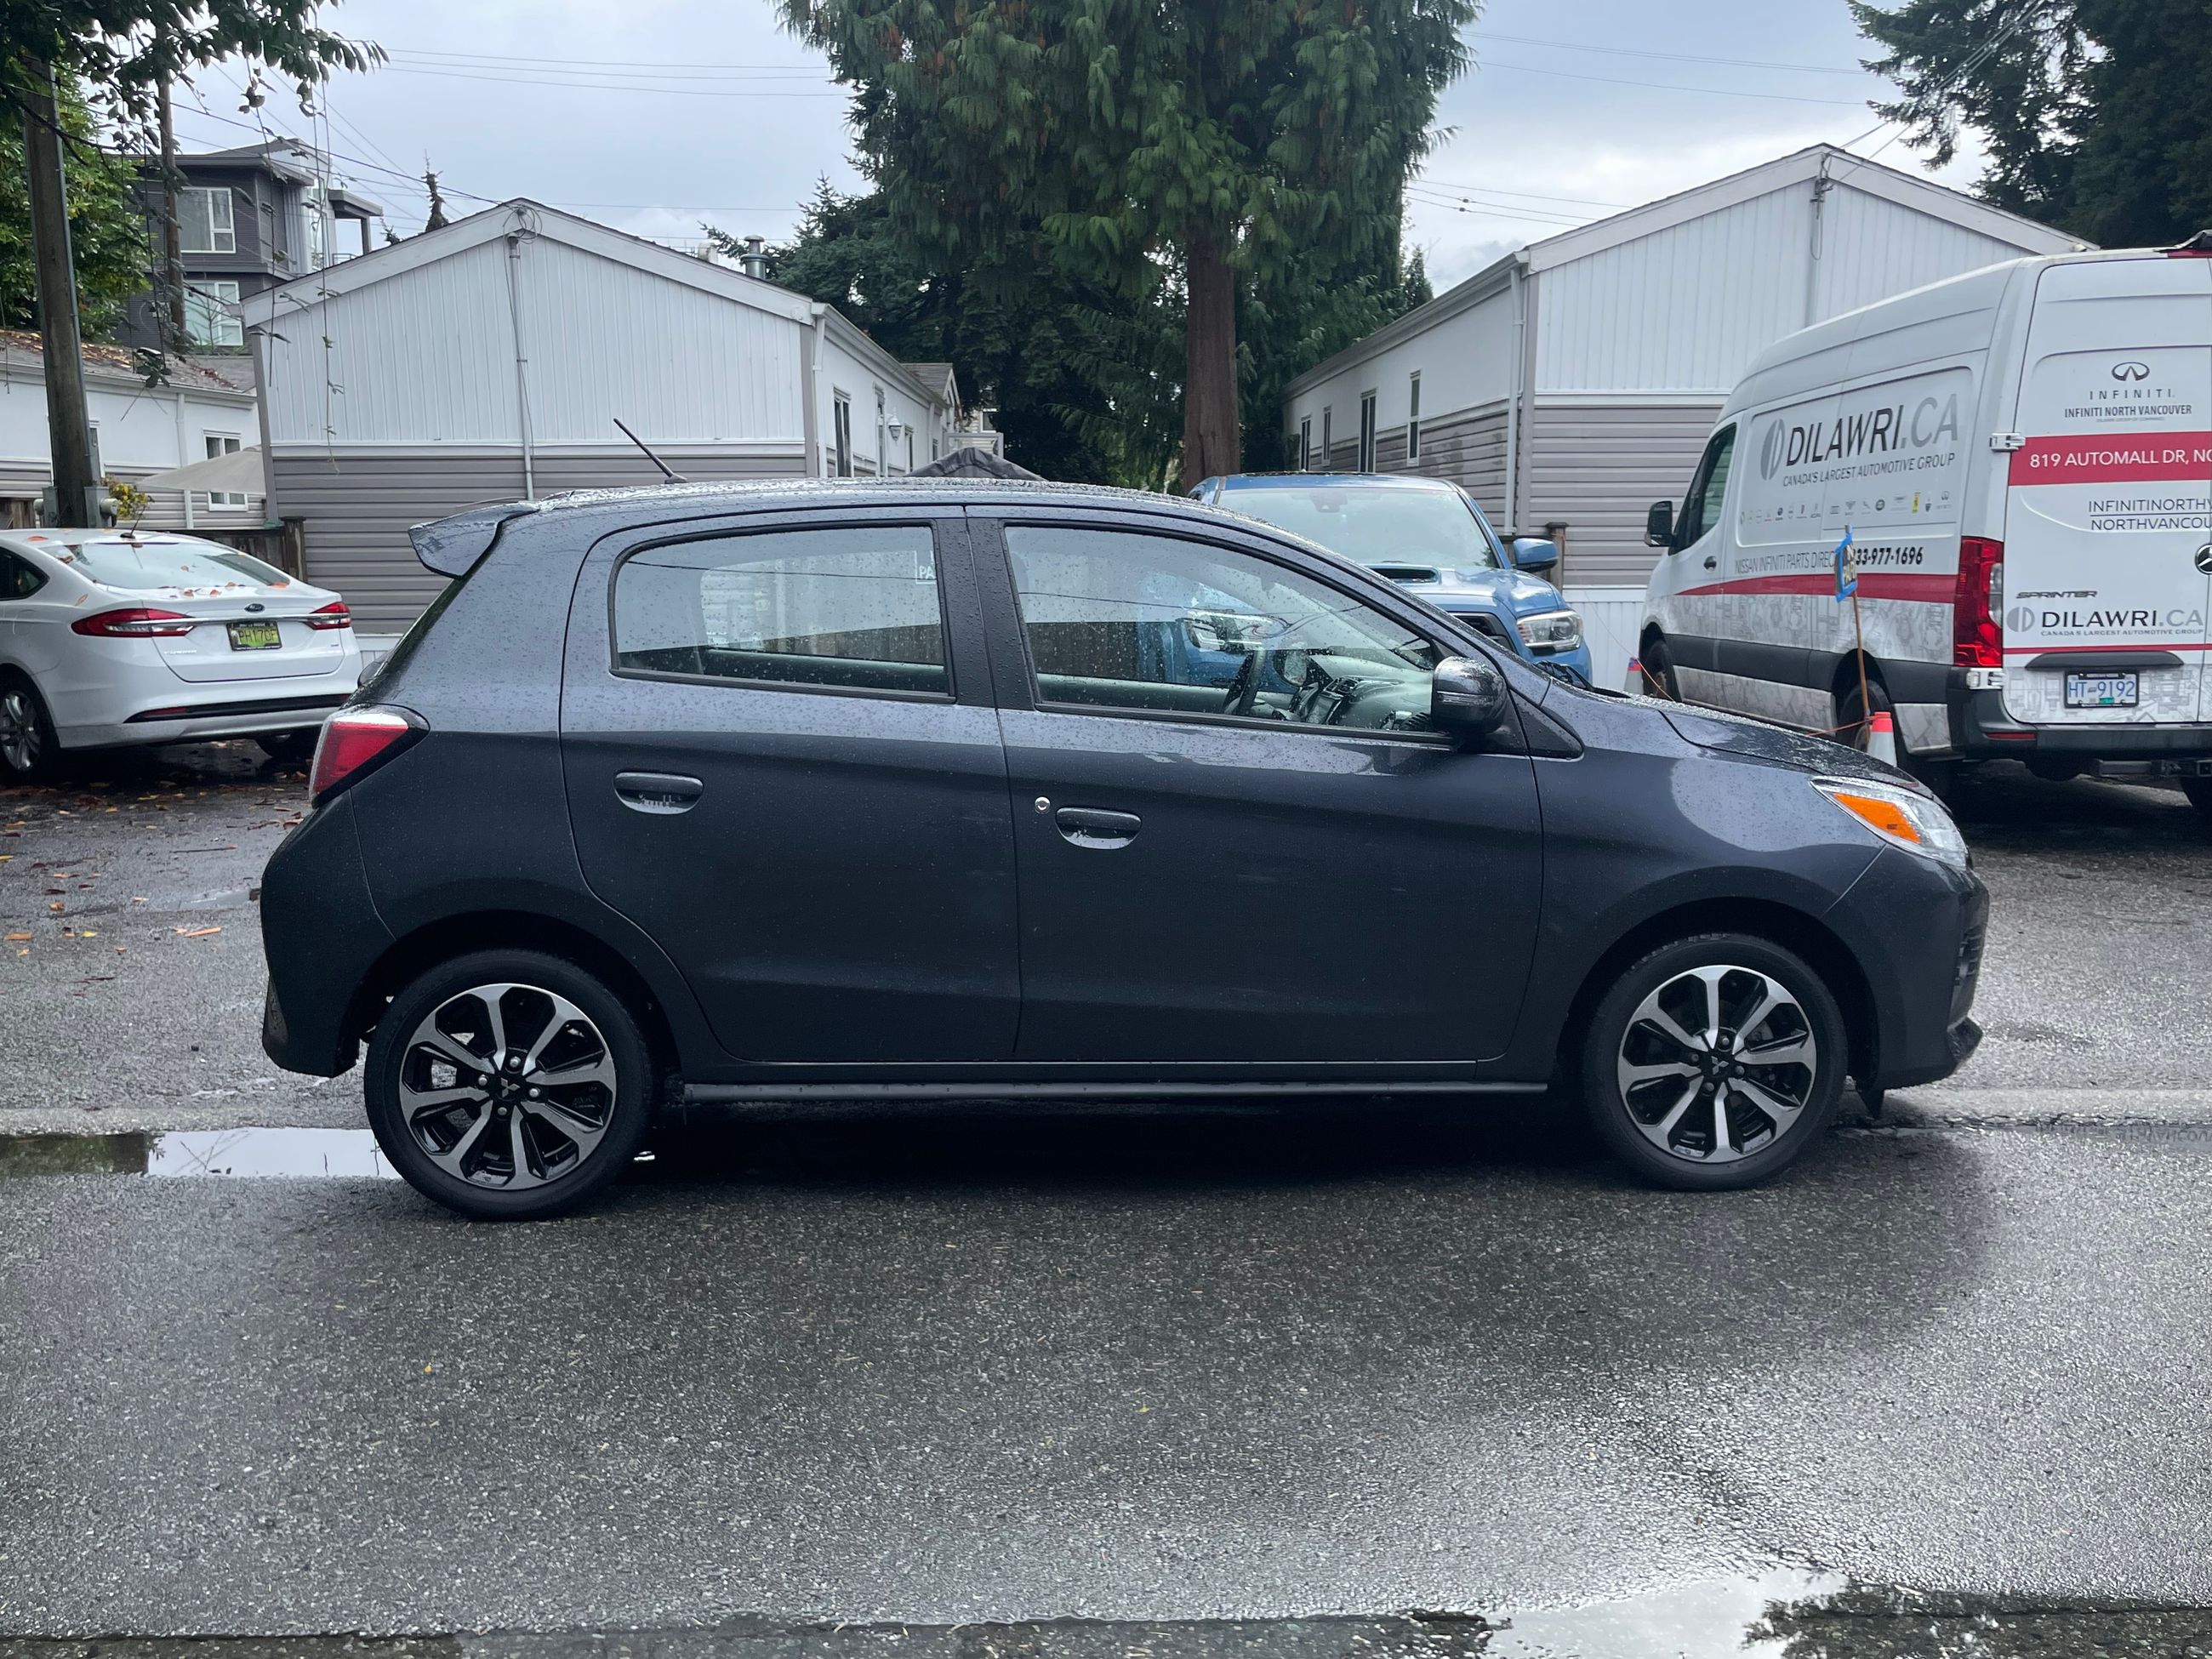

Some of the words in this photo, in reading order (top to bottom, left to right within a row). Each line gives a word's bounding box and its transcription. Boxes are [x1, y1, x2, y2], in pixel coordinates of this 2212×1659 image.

[2089, 389, 2171, 400] INFINITI
[2065, 407, 2102, 418] INFINITI
[2105, 406, 2135, 416] NORTH
[2138, 405, 2192, 415] VANCOUVER
[1786, 394, 1958, 467] DILAWRI.CA
[2030, 453, 2061, 468] 819
[2064, 451, 2158, 466] AUTOMALL
[2163, 449, 2189, 465] DR,
[1782, 470, 1818, 487] CANADA'S
[1819, 466, 1856, 482] LARGEST
[1857, 458, 1915, 477] AUTOMOTIVE
[1917, 453, 1955, 470] GROUP
[1736, 558, 1758, 573] NISSAN
[1787, 552, 1810, 570] PARTS
[1810, 550, 1836, 568] DIREC
[1854, 547, 1924, 566] 33-977-1696
[2016, 590, 2098, 599] SPRINTER
[2042, 609, 2203, 628] DILAWRI.CA
